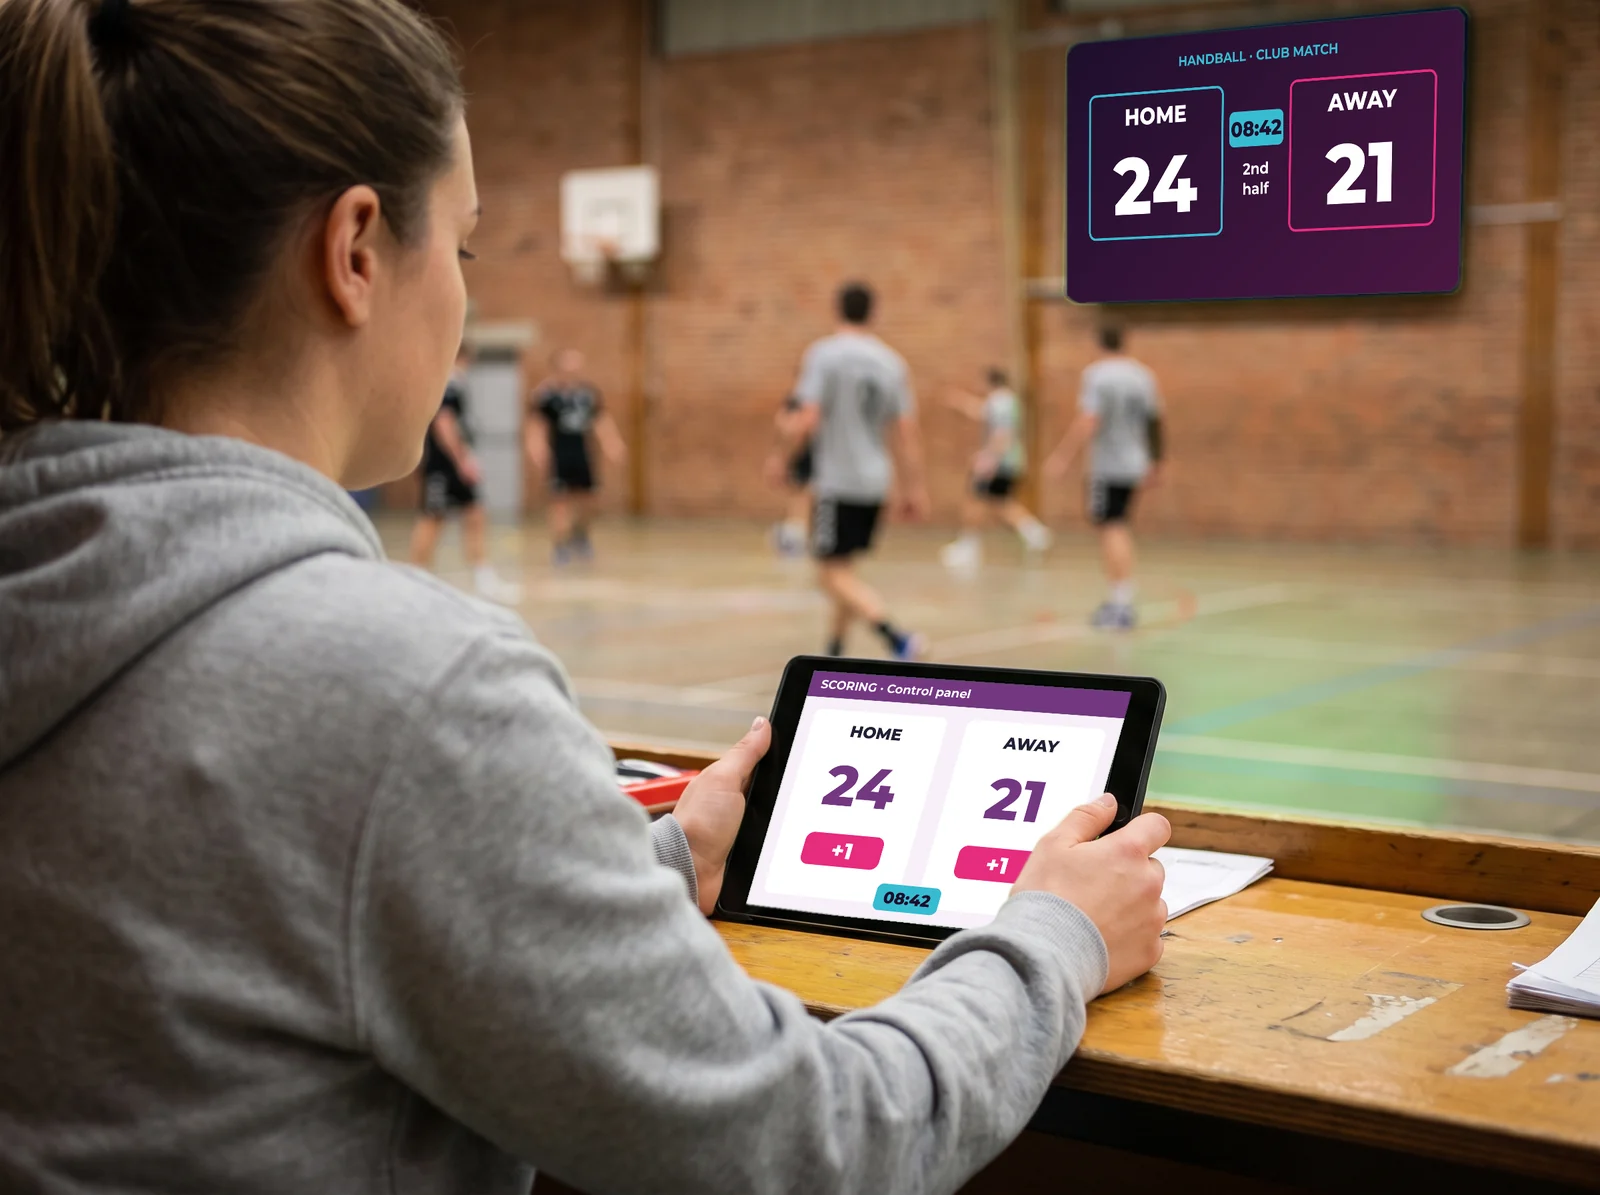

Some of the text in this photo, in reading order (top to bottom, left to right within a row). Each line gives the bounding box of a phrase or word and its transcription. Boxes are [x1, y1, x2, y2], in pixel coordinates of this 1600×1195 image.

[1178, 51, 1246, 67] HANDBALL
[1256, 47, 1290, 61] CLUB
[1293, 43, 1338, 58] MATCH
[1327, 89, 1398, 112] AWAY
[1125, 105, 1186, 127] HOME
[1231, 119, 1282, 138] 08:42
[1243, 162, 1269, 176] 2nd
[1325, 141, 1393, 205] 21
[1113, 154, 1197, 216] 24
[1243, 182, 1269, 196] half
[821, 679, 877, 692] SCORING
[886, 683, 933, 698] Control
[935, 686, 971, 701] panel
[849, 725, 903, 742] HOME
[1002, 737, 1059, 753] AWAY
[821, 765, 895, 810] 24
[983, 778, 1046, 823] 21
[832, 843, 854, 860] +1
[986, 857, 1009, 875] +1
[883, 891, 931, 908] 08:42
